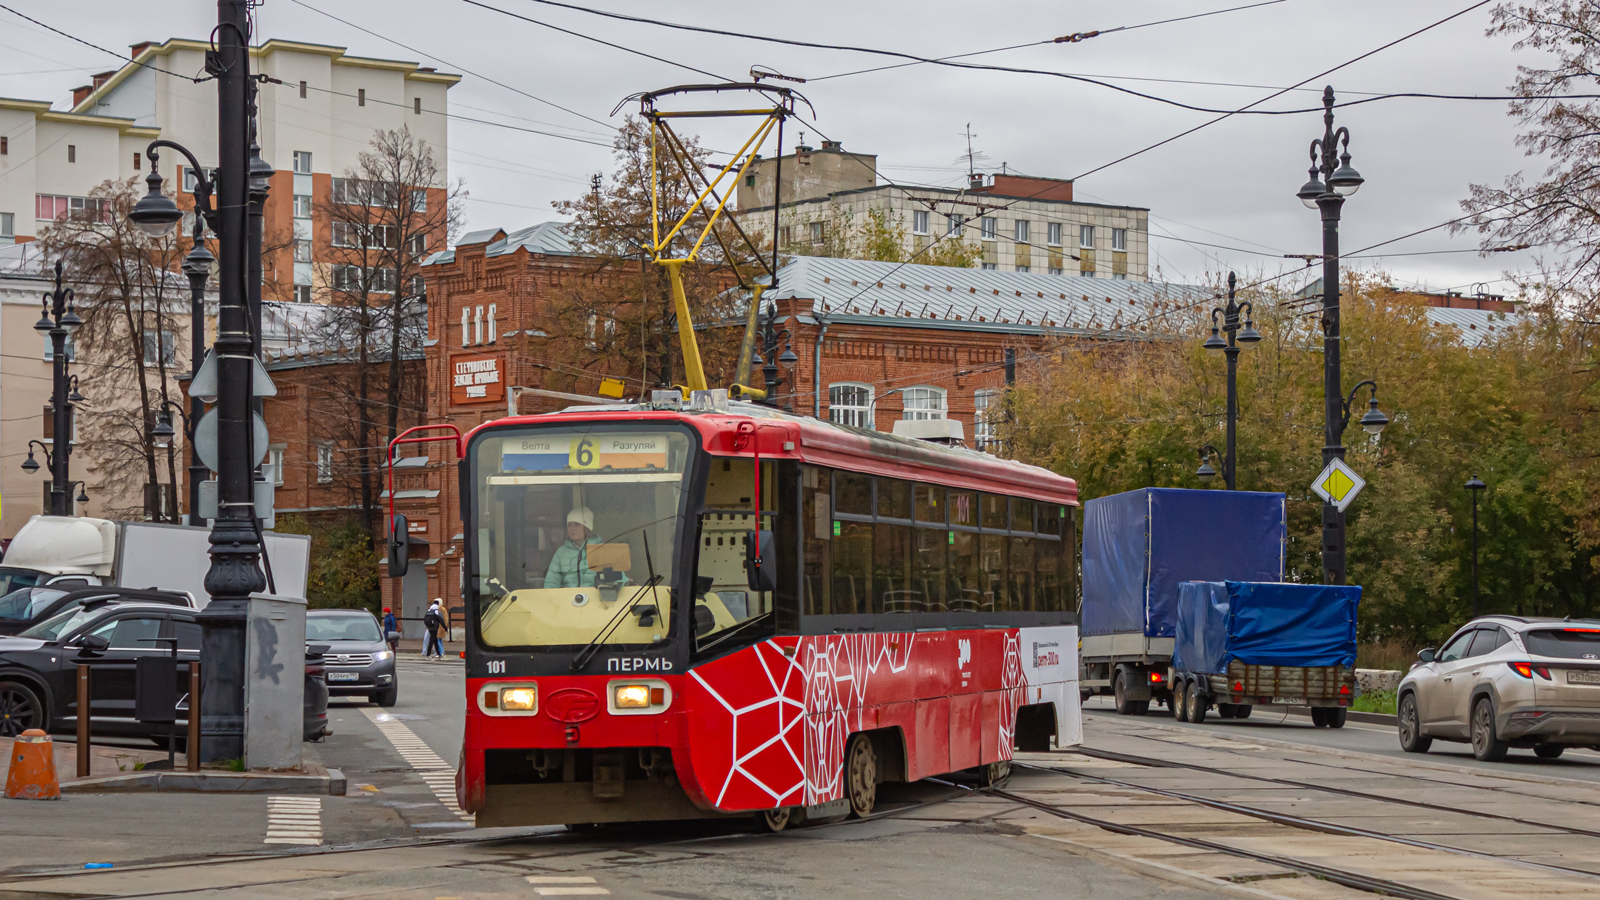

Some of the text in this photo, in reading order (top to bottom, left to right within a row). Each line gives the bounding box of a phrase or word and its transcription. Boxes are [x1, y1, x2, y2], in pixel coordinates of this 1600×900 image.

[521, 441, 550, 450] Велта
[613, 440, 656, 451] Разгуляй
[576, 440, 593, 466] 6
[486, 660, 506, 674] 101
[607, 658, 673, 672] ПЕРМЬ
